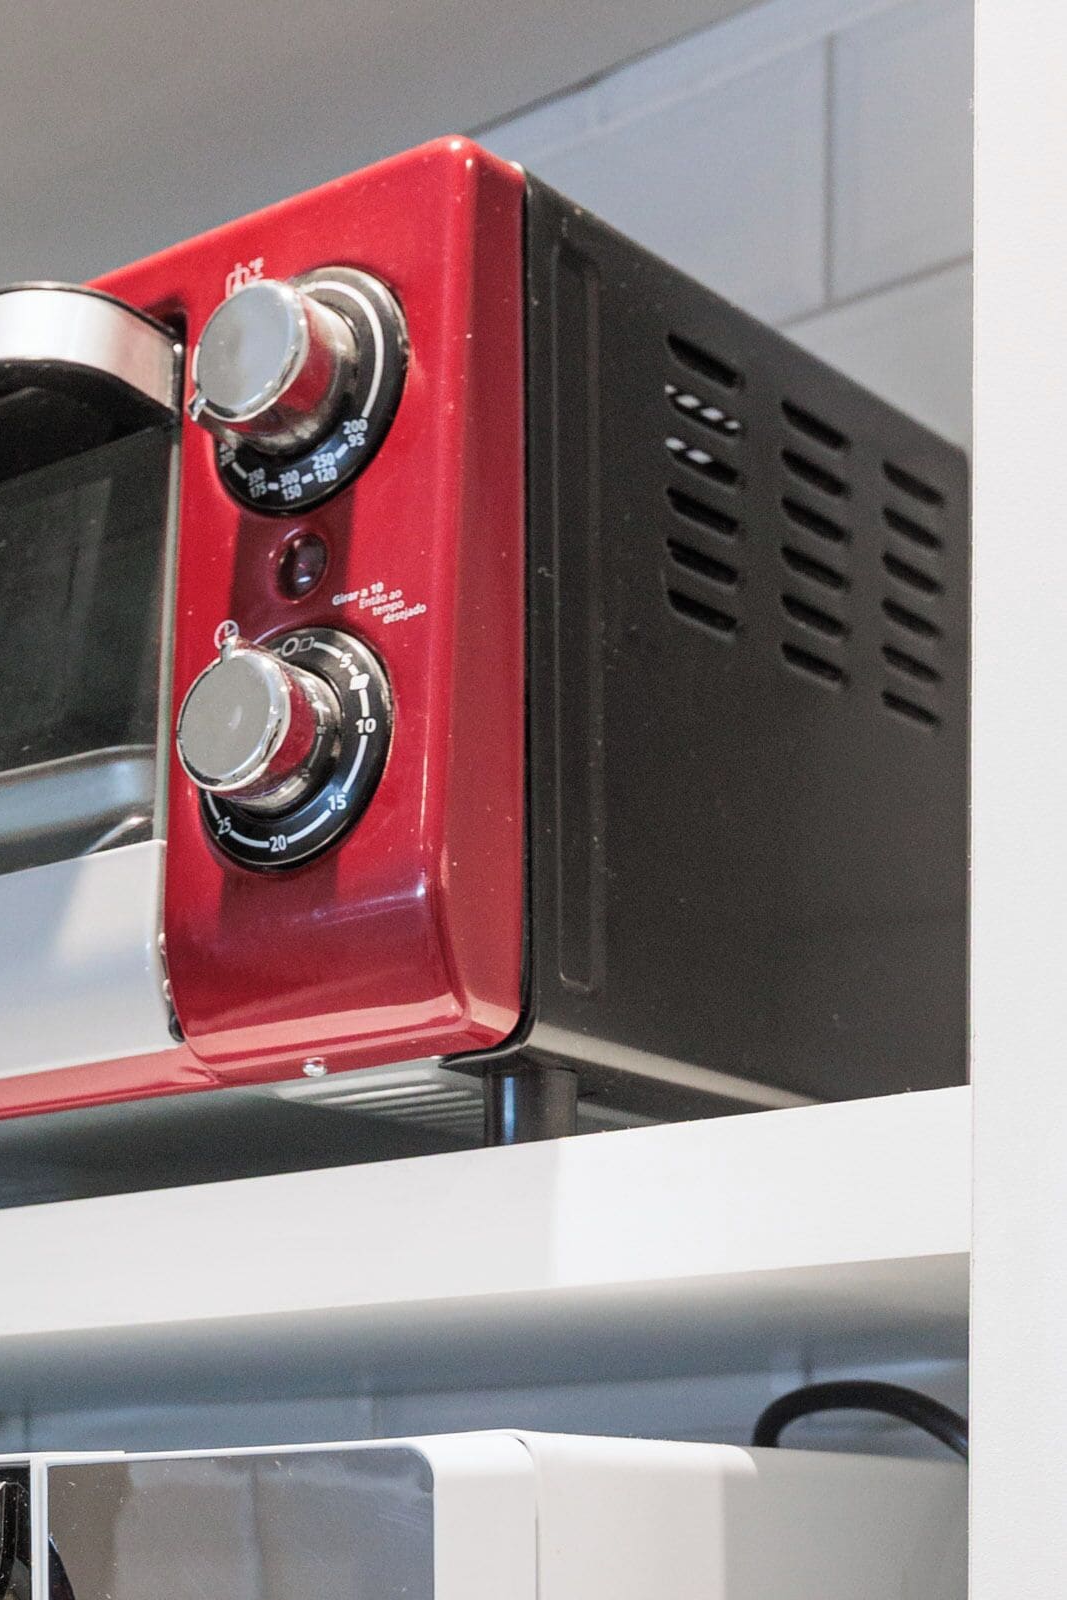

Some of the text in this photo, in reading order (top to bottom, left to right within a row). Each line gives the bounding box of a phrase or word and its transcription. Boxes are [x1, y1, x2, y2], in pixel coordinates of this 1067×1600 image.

[342, 418, 368, 436] 200
[347, 432, 366, 448] 95
[311, 452, 336, 471] 250
[278, 469, 300, 489] 300
[315, 466, 338, 484] 120
[281, 483, 303, 502] 150
[338, 654, 353, 669] 5
[355, 717, 376, 735] 10
[327, 793, 347, 811] 15
[216, 817, 232, 835] 25
[268, 835, 288, 853] 20
